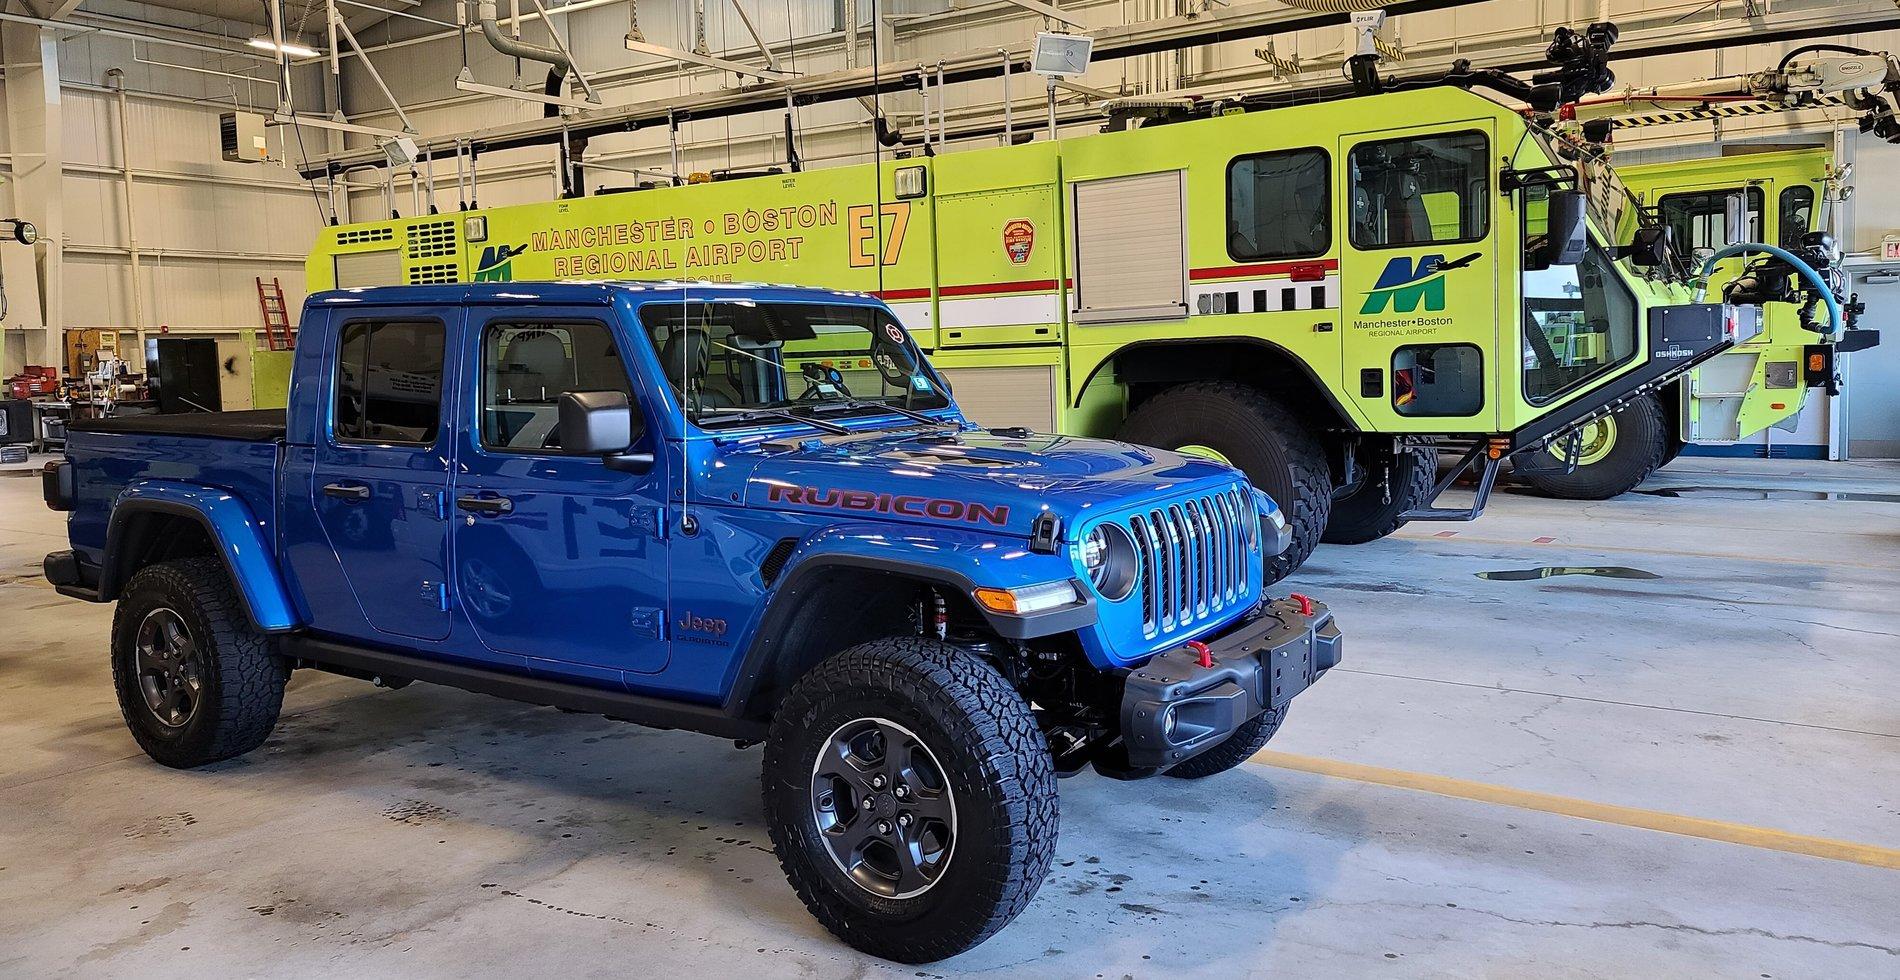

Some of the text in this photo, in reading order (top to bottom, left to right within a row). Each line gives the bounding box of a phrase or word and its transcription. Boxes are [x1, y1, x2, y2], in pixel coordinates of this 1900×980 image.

[531, 202, 838, 252] MANCHESTER BOSTON
[847, 201, 912, 268] E7
[554, 237, 804, 277] REGIONAL AIRPORT
[1405, 328, 1437, 336] AIRPORT
[1656, 348, 1694, 358] OSHKOSH
[767, 483, 1011, 527] RUBICON
[676, 634, 729, 647] GLADIATOR
[679, 610, 727, 639] Jeep
